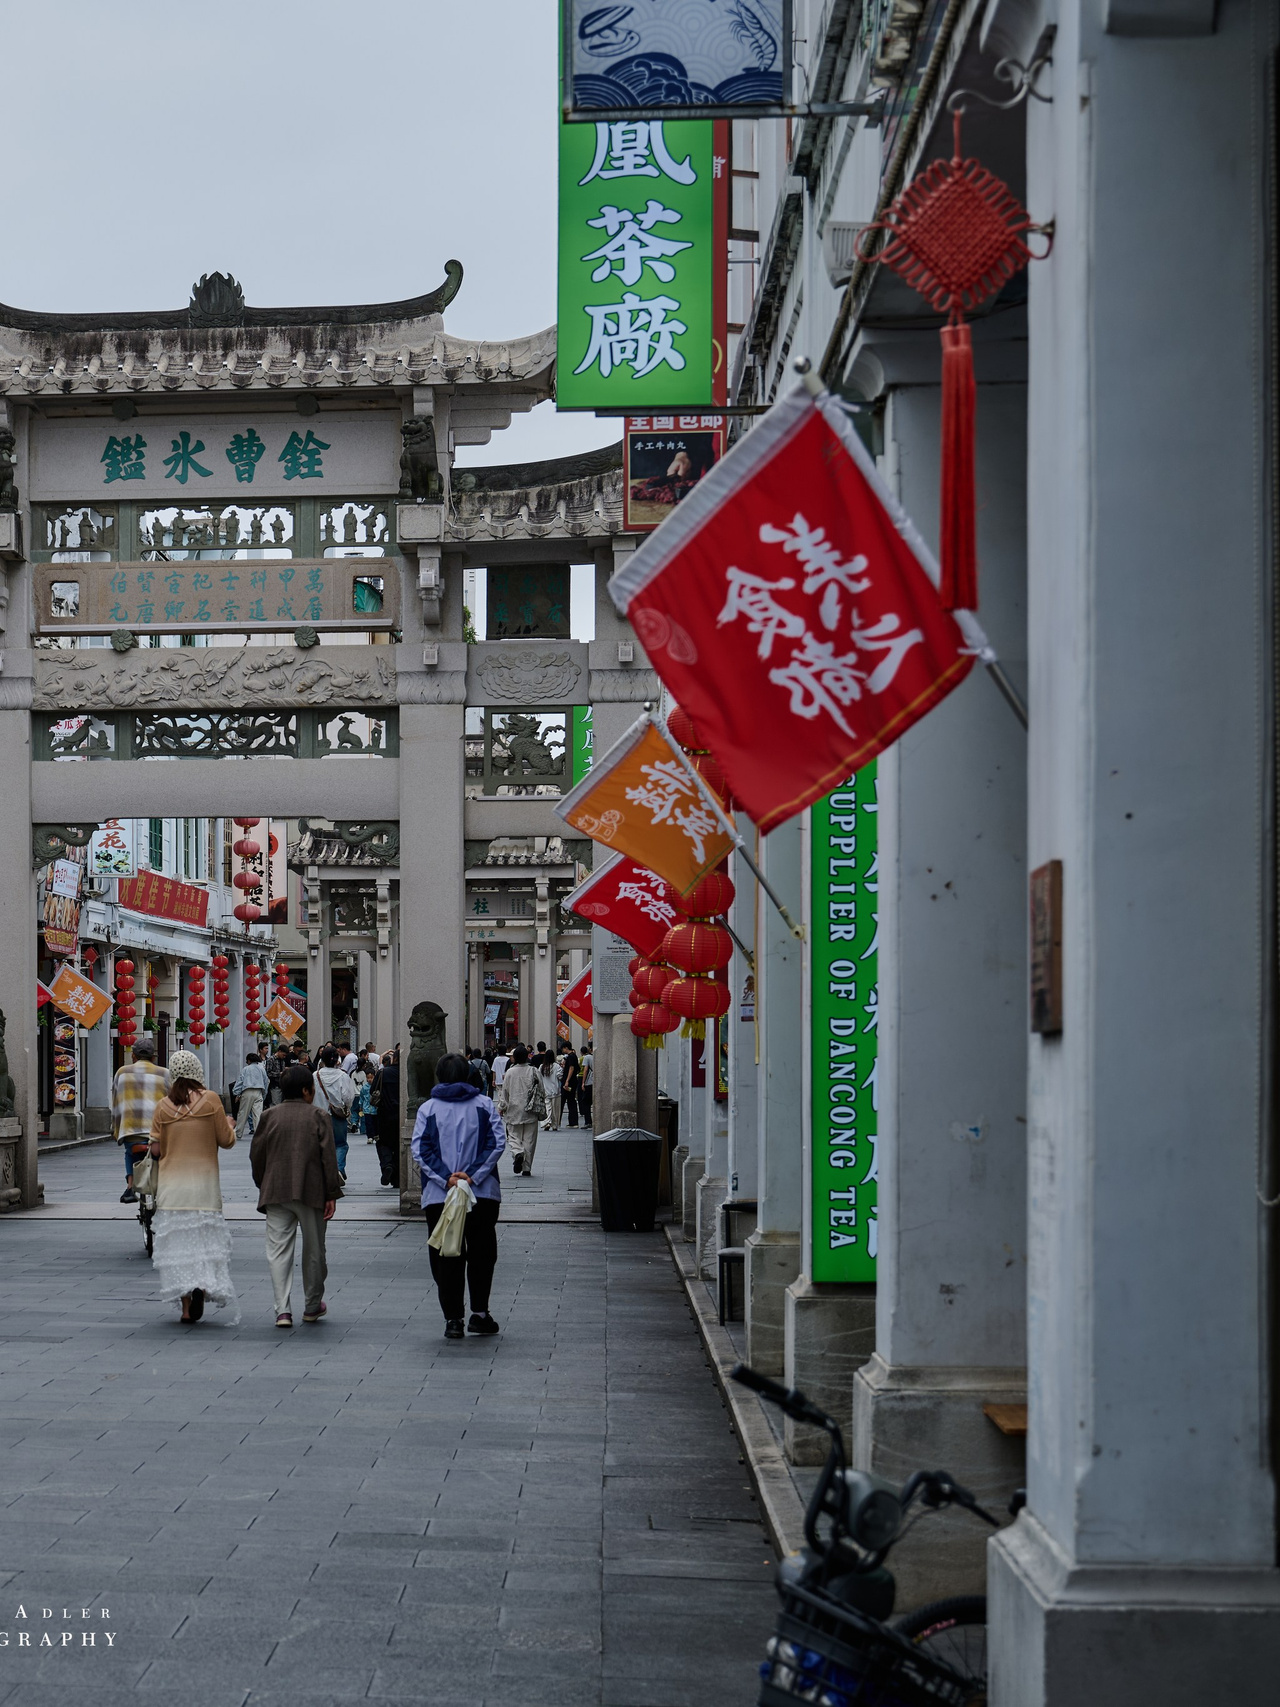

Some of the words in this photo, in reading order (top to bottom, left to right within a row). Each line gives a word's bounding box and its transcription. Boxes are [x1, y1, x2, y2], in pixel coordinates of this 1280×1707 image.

[634, 440, 687, 451] 手工牛肉丸
[828, 772, 858, 942] SUPPLIER
[472, 898, 490, 915] 柱
[828, 959, 858, 1000] OF
[828, 1017, 858, 1169] DANCONG
[828, 1186, 858, 1250] TEA
